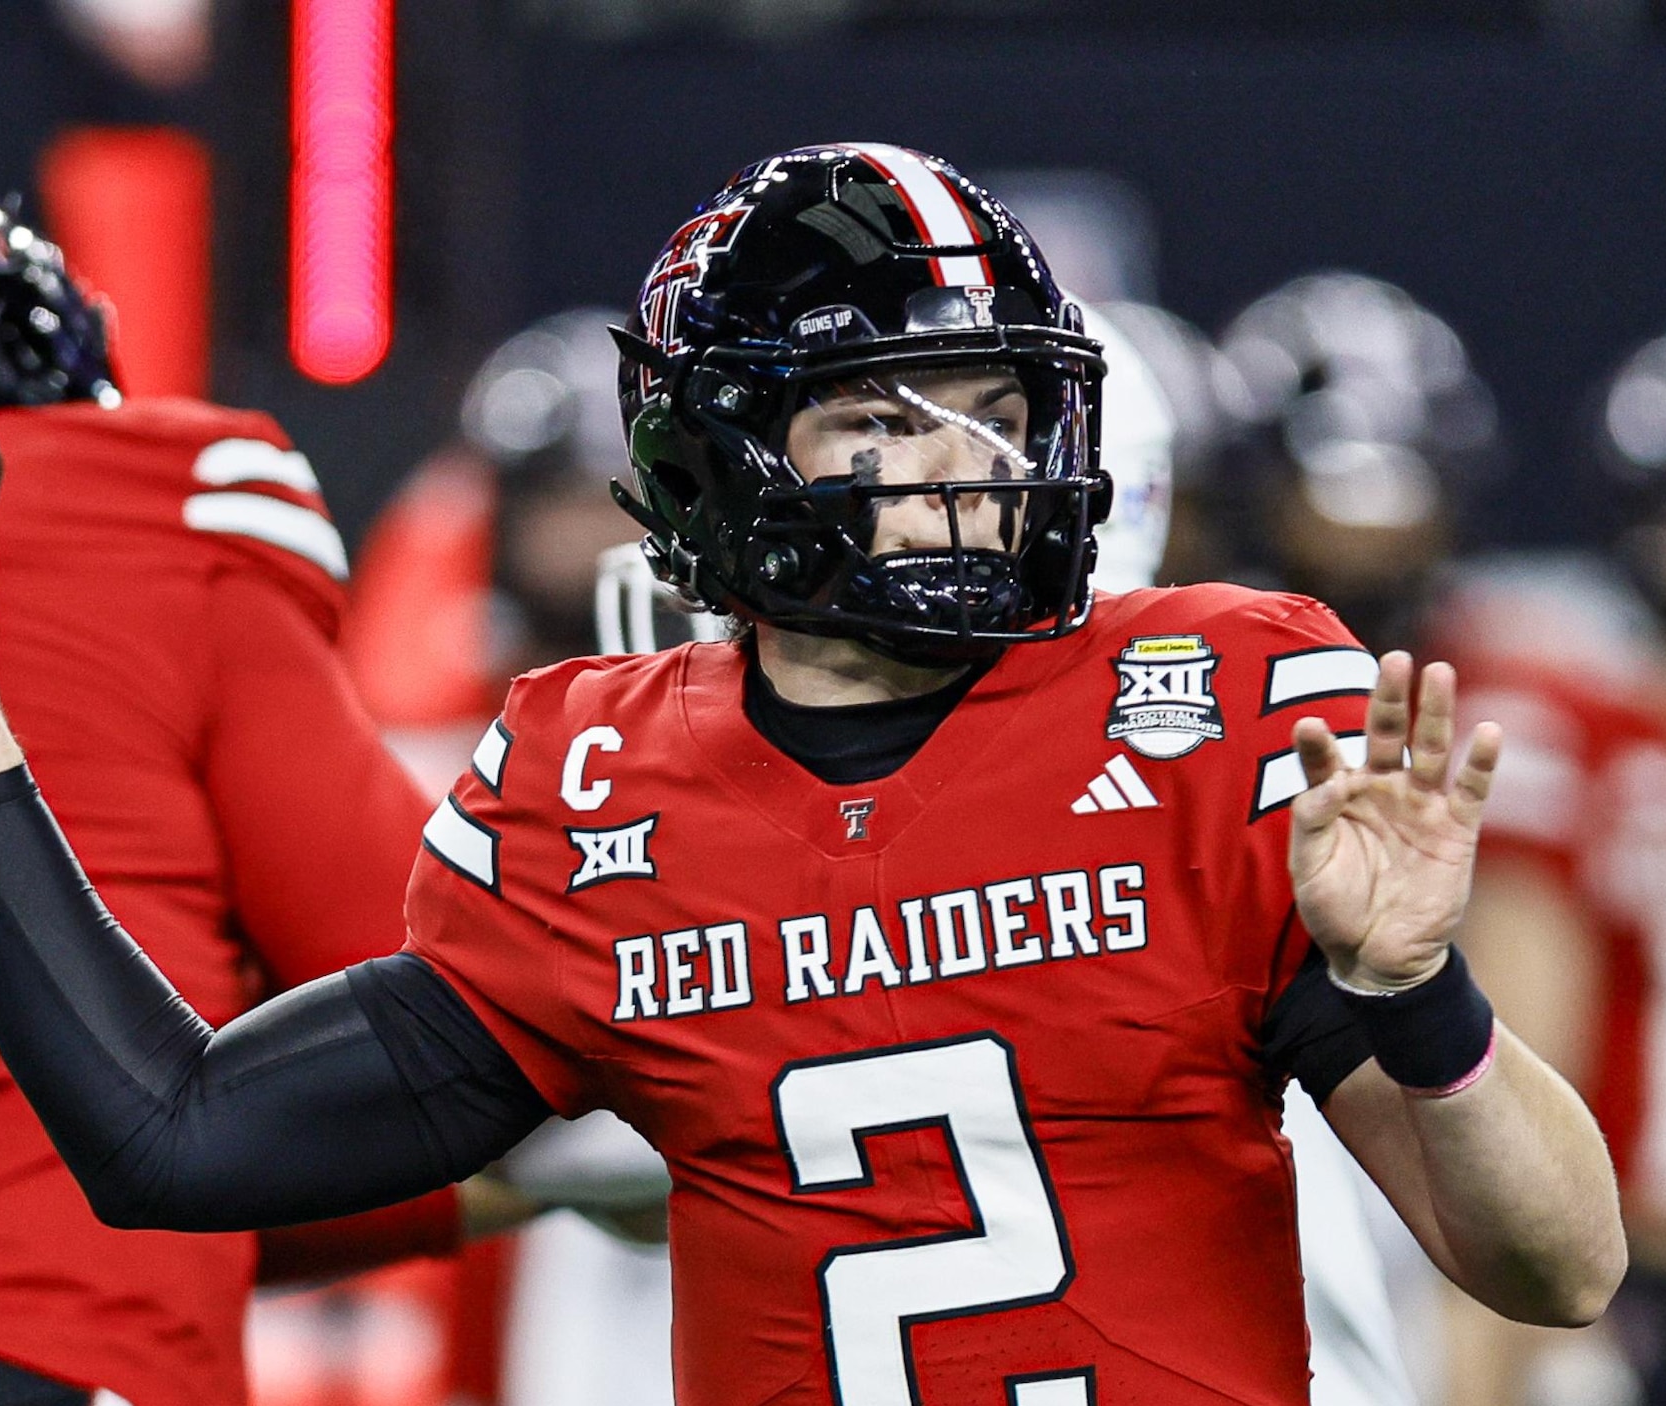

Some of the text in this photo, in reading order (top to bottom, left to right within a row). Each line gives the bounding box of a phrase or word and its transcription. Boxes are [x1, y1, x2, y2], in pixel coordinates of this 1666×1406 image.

[799, 310, 853, 336] GUNS UP
[1115, 659, 1216, 707] XII
[1107, 718, 1223, 733] CHAMPIONSHIP
[1128, 709, 1203, 722] FOOTBALL
[561, 726, 623, 811] C
[568, 815, 658, 890] XII
[612, 862, 1148, 1021] RED RAIDERS
